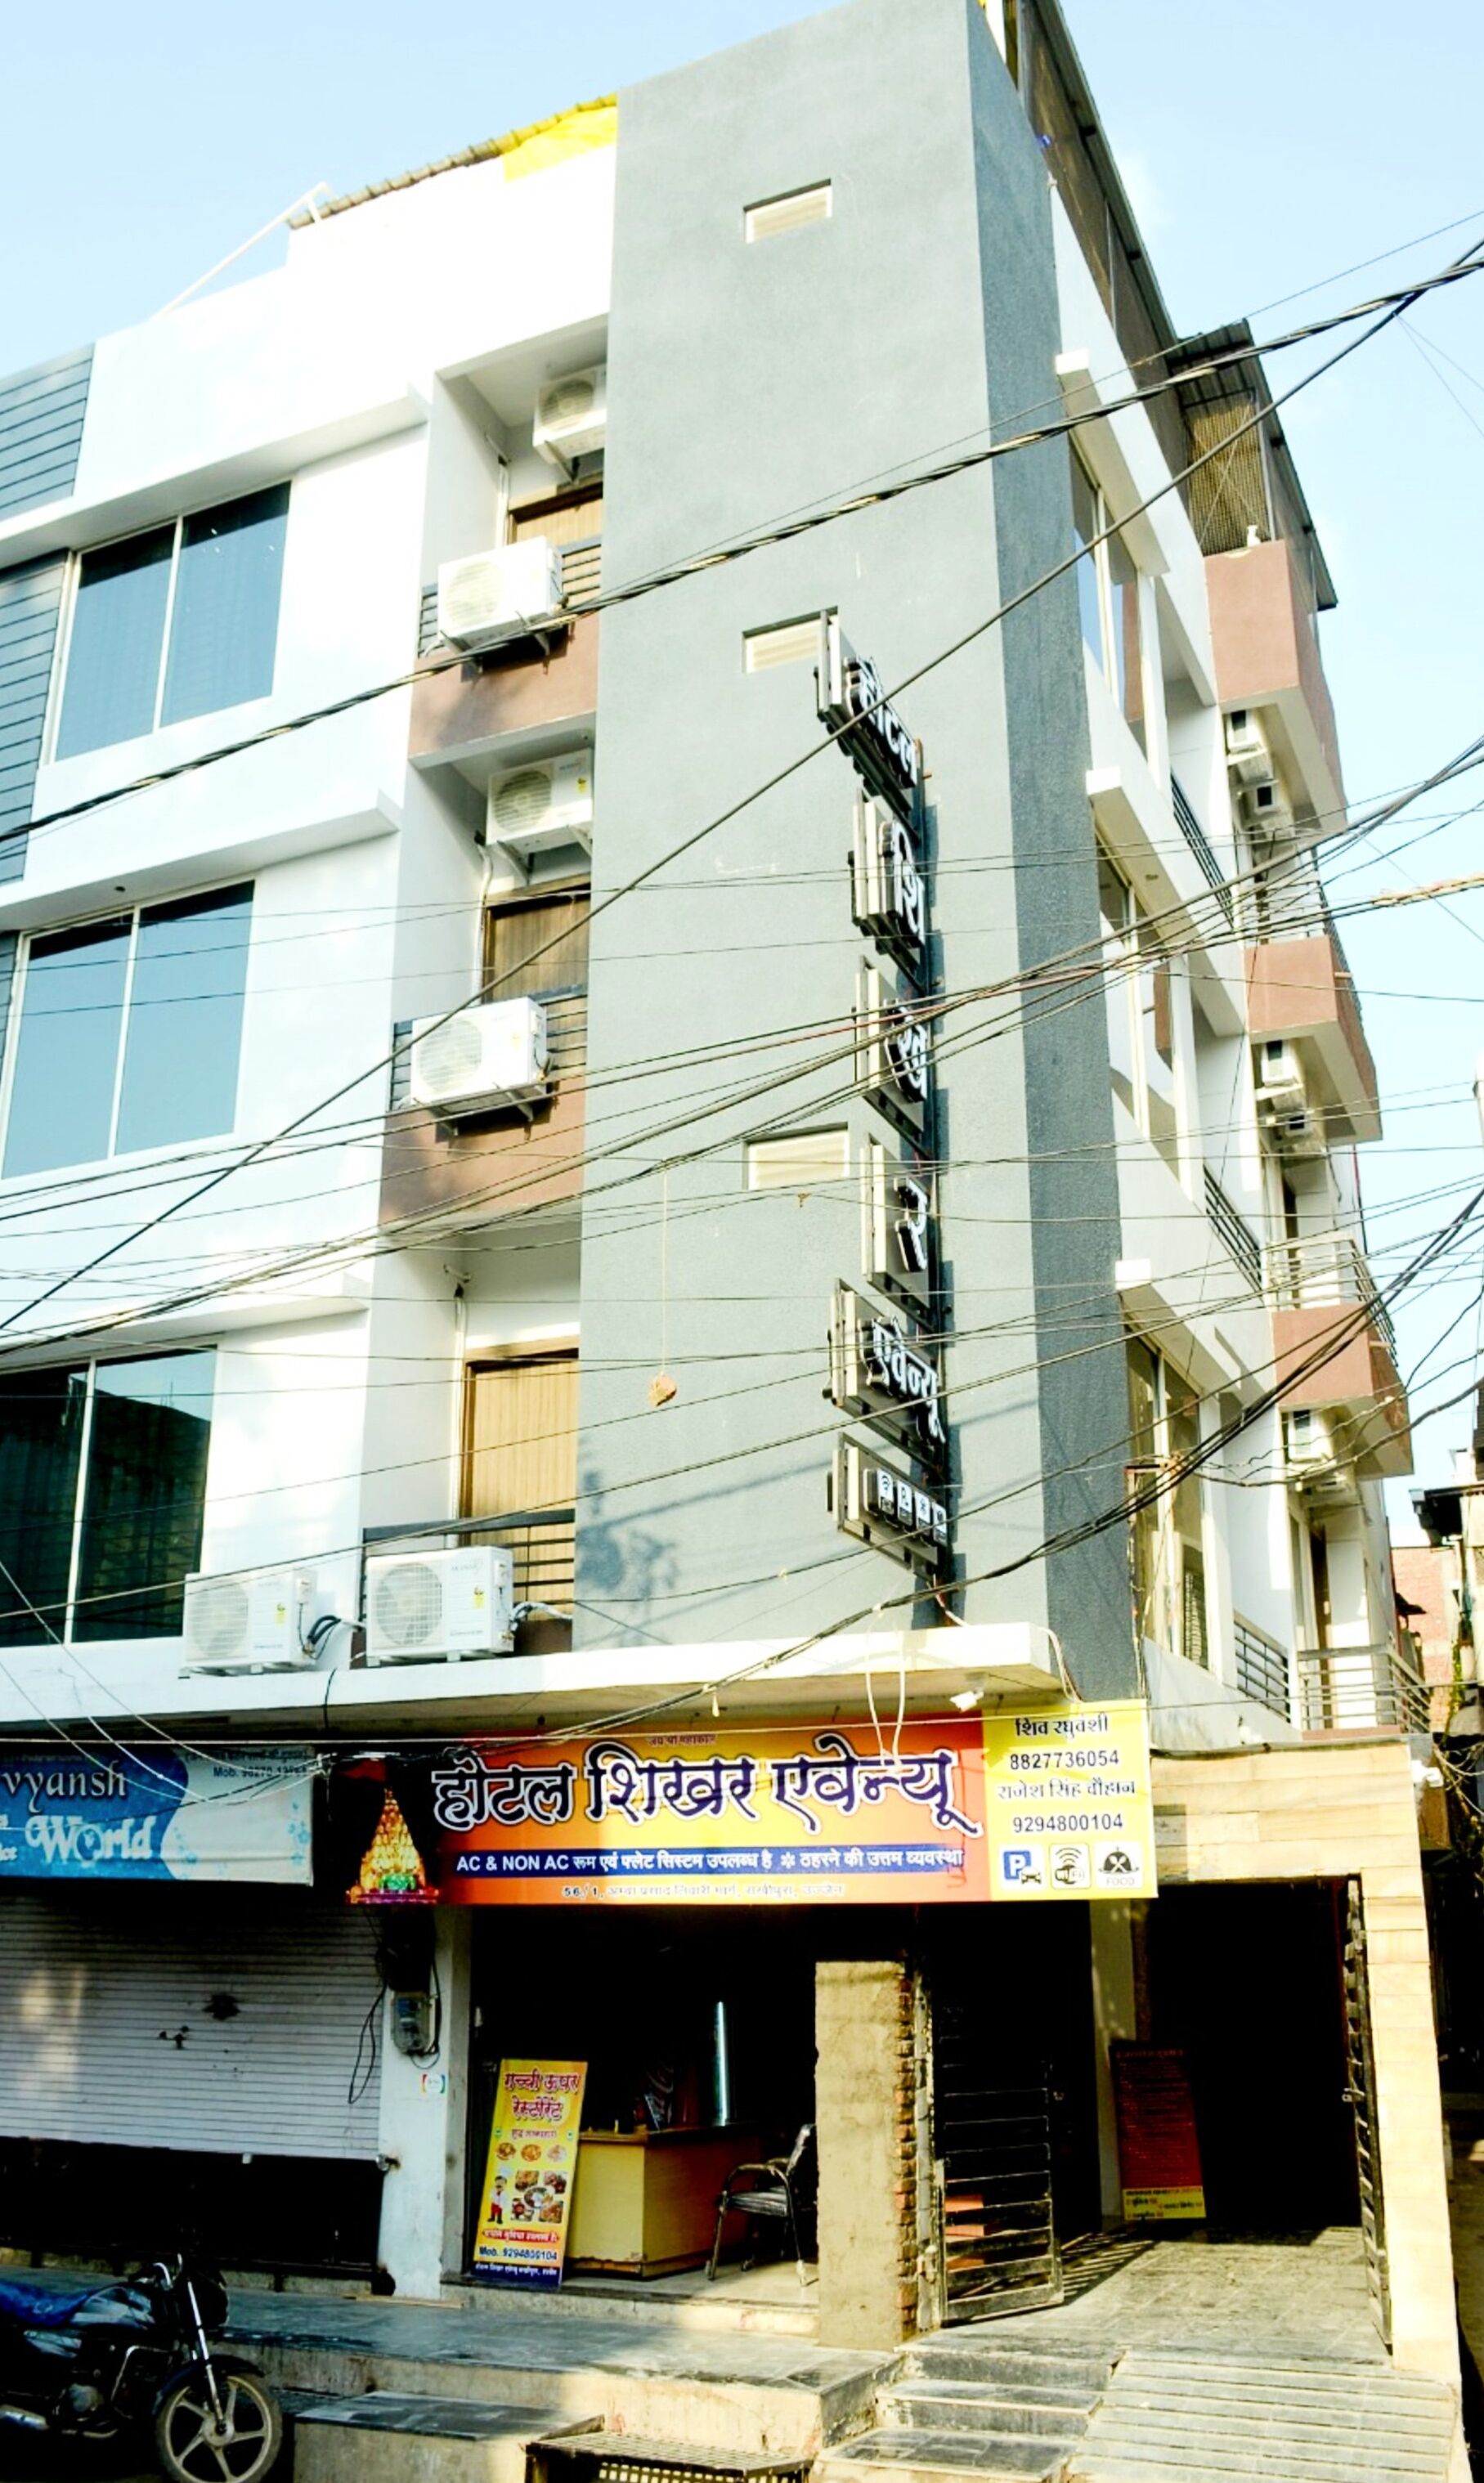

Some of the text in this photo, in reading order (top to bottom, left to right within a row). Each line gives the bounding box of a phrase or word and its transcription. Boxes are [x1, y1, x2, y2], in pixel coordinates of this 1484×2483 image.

[1015, 1712, 1110, 1739] शिव रघुवंशी
[1010, 1750, 1119, 1770] 8827736054
[432, 1733, 983, 1838] होटल शिखर एवेन्यू
[998, 1777, 1136, 1799] राजेश सिंह चौहान
[1013, 1813, 1123, 1833] 9294800104
[25, 1815, 157, 1867] World
[457, 1848, 965, 1871] AC & NON AC रूम एवं फ्लेट सिस्टम उपलब्ध है ठहरने की उत्तम व्यवस्था
[1106, 1878, 1135, 1886] FOOD
